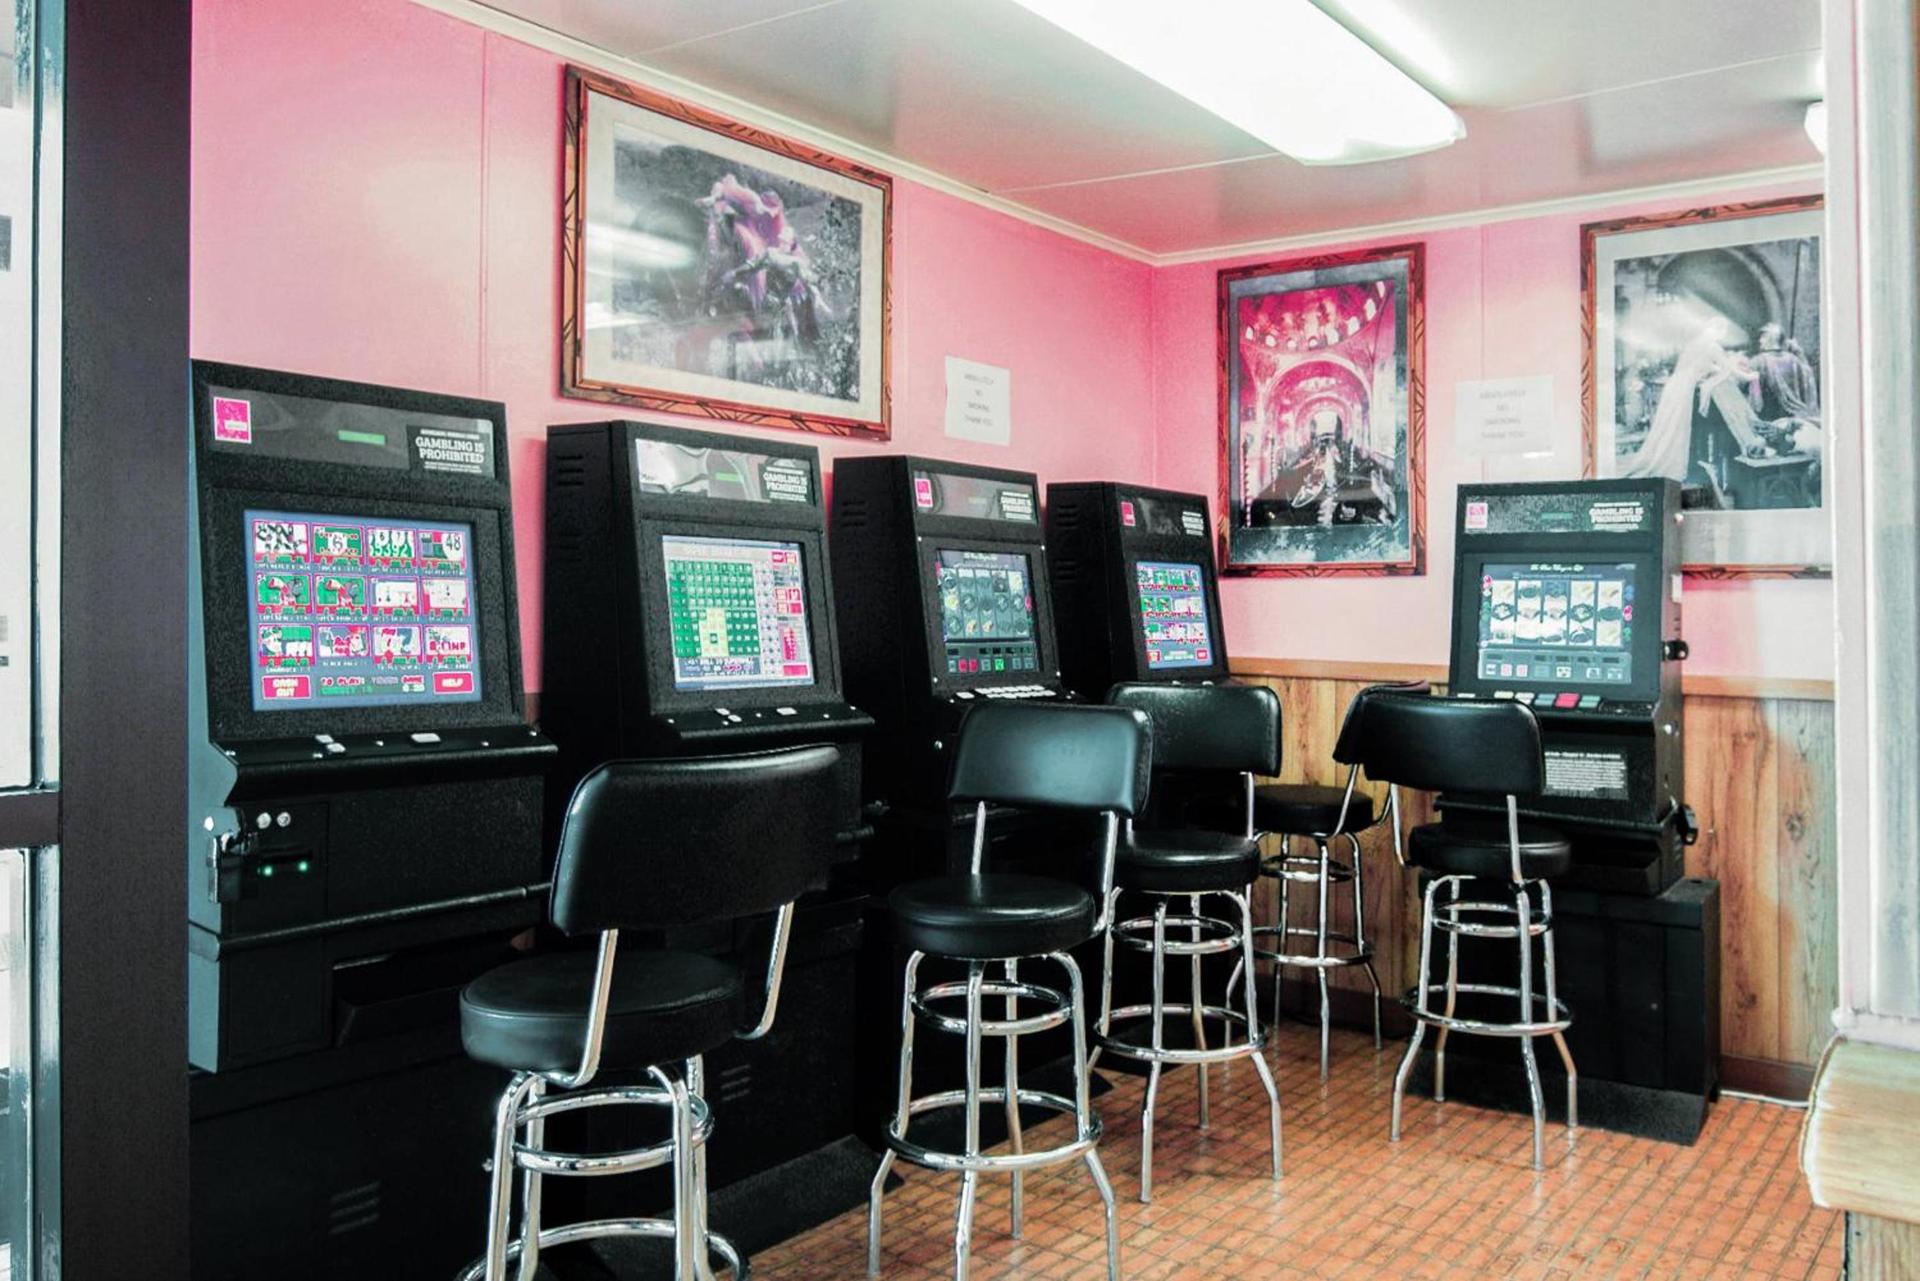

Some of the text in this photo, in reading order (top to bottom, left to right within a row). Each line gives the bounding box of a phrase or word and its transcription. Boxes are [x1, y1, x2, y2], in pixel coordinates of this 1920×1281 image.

[415, 436, 485, 454] GAMBLING IS
[419, 448, 485, 463] PROHIBITED
[1589, 507, 1633, 516] GAMBLING
